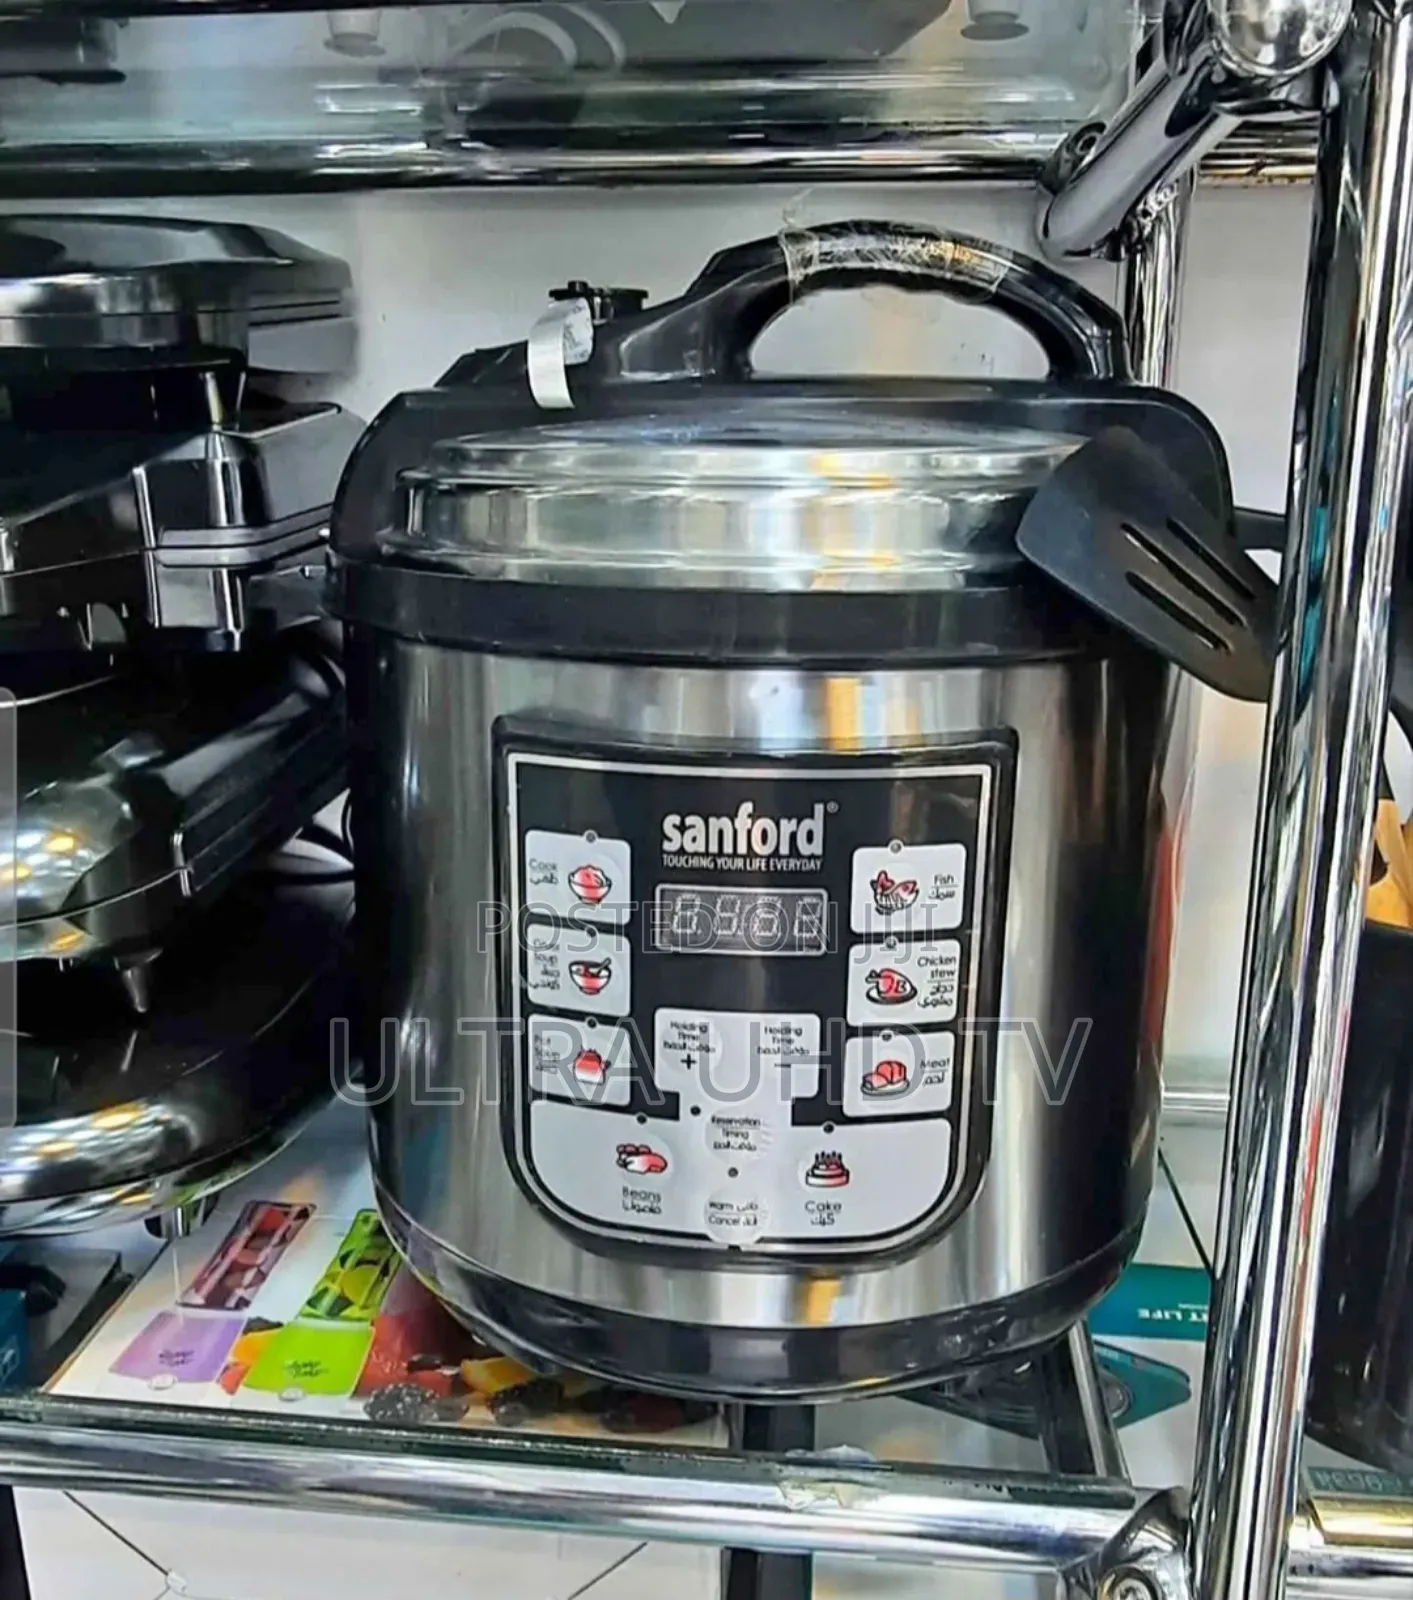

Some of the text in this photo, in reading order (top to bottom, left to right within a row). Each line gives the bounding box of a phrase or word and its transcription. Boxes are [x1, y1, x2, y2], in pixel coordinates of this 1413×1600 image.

[662, 801, 824, 856] sanford
[529, 858, 558, 871] Cook
[662, 854, 823, 872] TOUCHING YOUR LIFE EVERYDAY
[933, 873, 955, 885] Fish
[917, 955, 957, 968] Chicken
[931, 968, 956, 979] stew
[670, 1020, 708, 1034] Holding
[764, 1025, 803, 1037] Holding
[678, 1031, 699, 1041] Time
[772, 1036, 795, 1045] Time
[920, 1057, 950, 1069] Meat
[711, 1114, 761, 1126] Reservation
[622, 1186, 662, 1202] Beans
[804, 1200, 842, 1213] Cake
[708, 1212, 740, 1226] Cancel
[1137, 1308, 1182, 1321] LIFE
